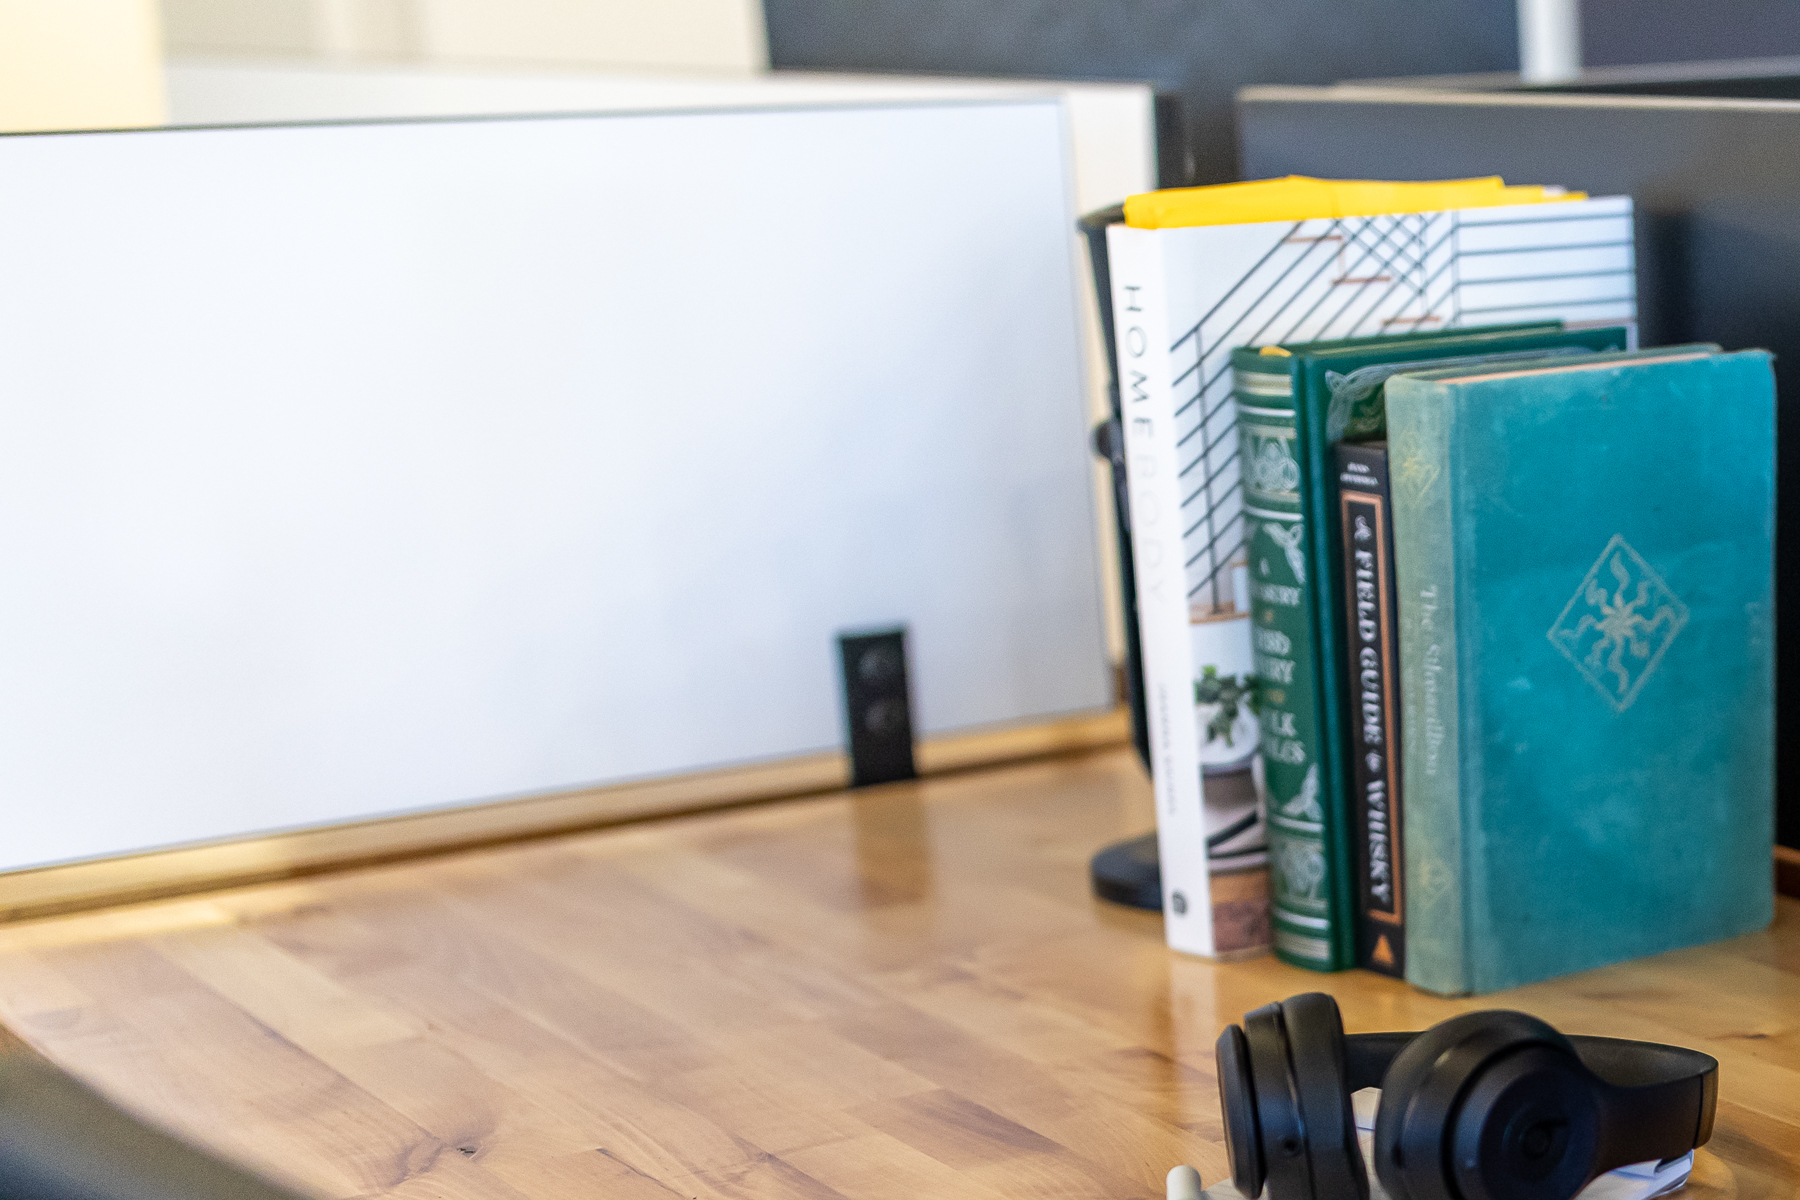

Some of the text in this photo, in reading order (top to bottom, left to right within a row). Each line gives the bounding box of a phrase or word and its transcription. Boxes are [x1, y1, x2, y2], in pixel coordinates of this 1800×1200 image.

[1355, 549, 1377, 643] FIELD
[1359, 646, 1383, 745] GUIDE
[1366, 780, 1390, 904] WHISKY
